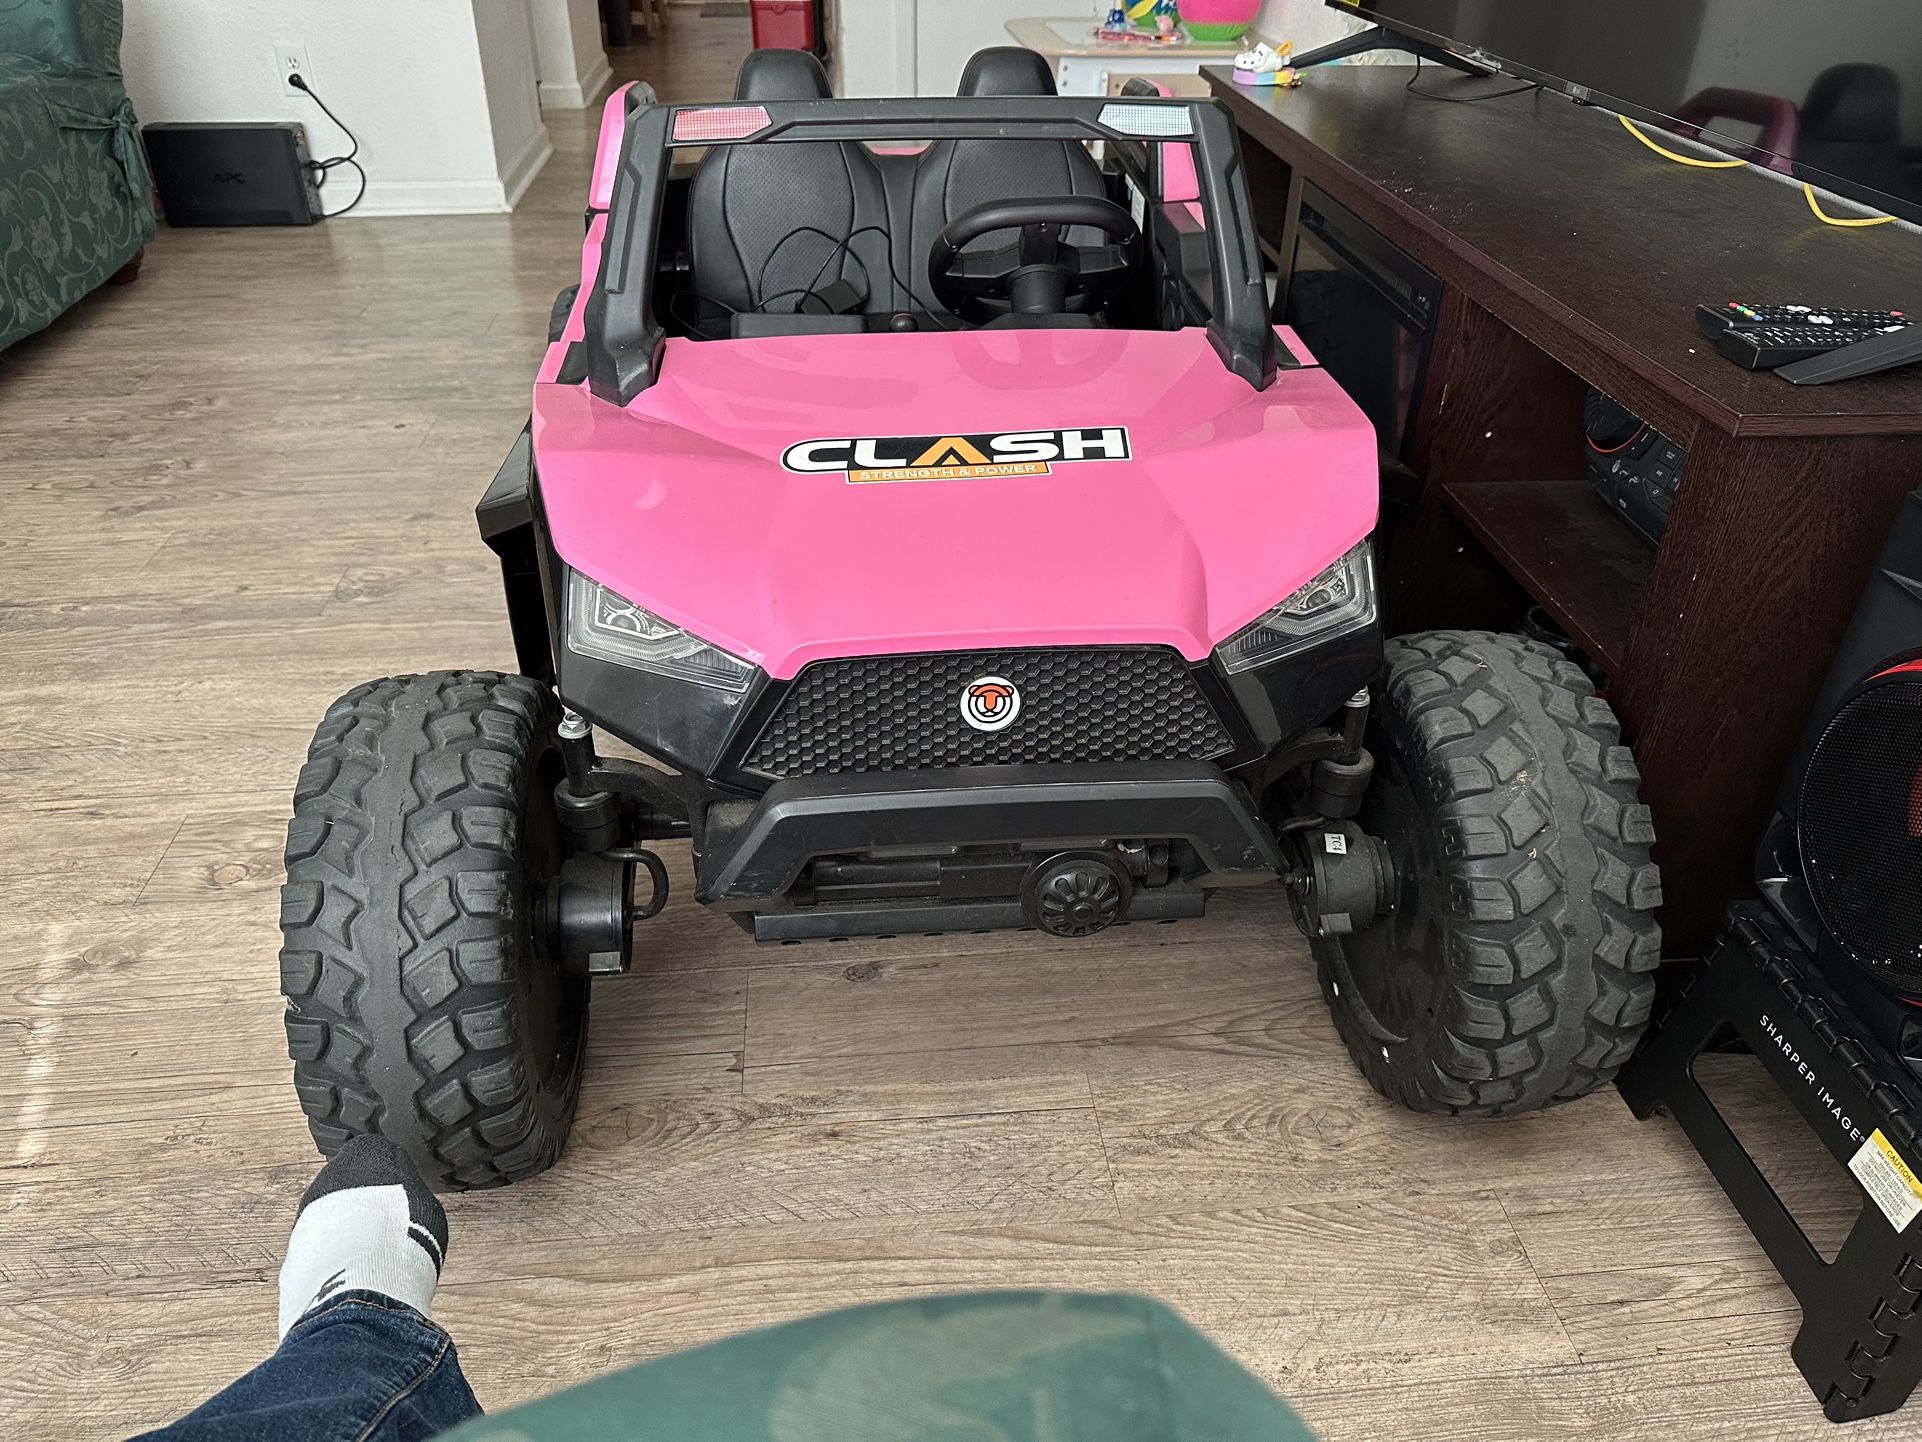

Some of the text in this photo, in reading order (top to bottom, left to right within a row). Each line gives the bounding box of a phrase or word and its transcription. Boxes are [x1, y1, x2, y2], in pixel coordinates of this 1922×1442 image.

[213, 172, 246, 184] APC
[787, 428, 1125, 471] CLASH
[859, 464, 1037, 481] STRENGTH & POWER
[1760, 1014, 1816, 1085] SHARPER
[1860, 1164, 1881, 1193] COMPLETELY
[1880, 1191, 1890, 1204] OPEN
[1883, 1158, 1897, 1176] WEIGHT
[1895, 1174, 1913, 1197] CAPACITY
[1886, 1148, 1912, 1184] CAUTION
[1857, 1169, 1867, 1182] LOCK
[1865, 1179, 1881, 1201] POSITION
[1879, 1199, 1893, 1217] BEFORE
[1870, 1167, 1886, 1189] SLIPPERY
[1884, 1187, 1902, 1211] SURFACES
[1891, 1187, 1906, 1207] UNEVEN
